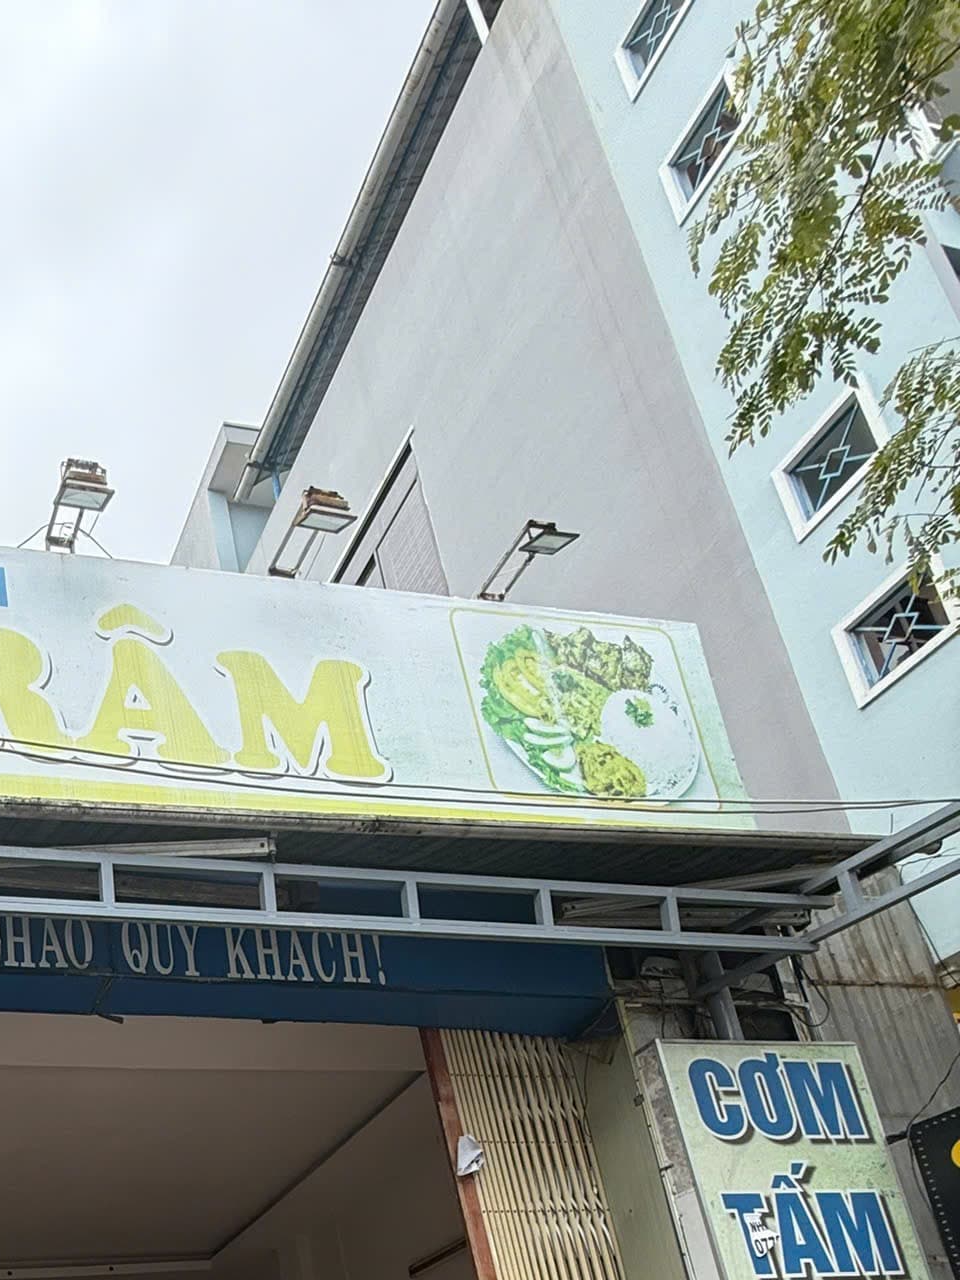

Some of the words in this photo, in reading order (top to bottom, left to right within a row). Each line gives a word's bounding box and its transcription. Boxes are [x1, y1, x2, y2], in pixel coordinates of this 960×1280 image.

[687, 1053, 869, 1141] CƠM
[721, 1162, 904, 1278] TẤM
[754, 1235, 780, 1255] 077
